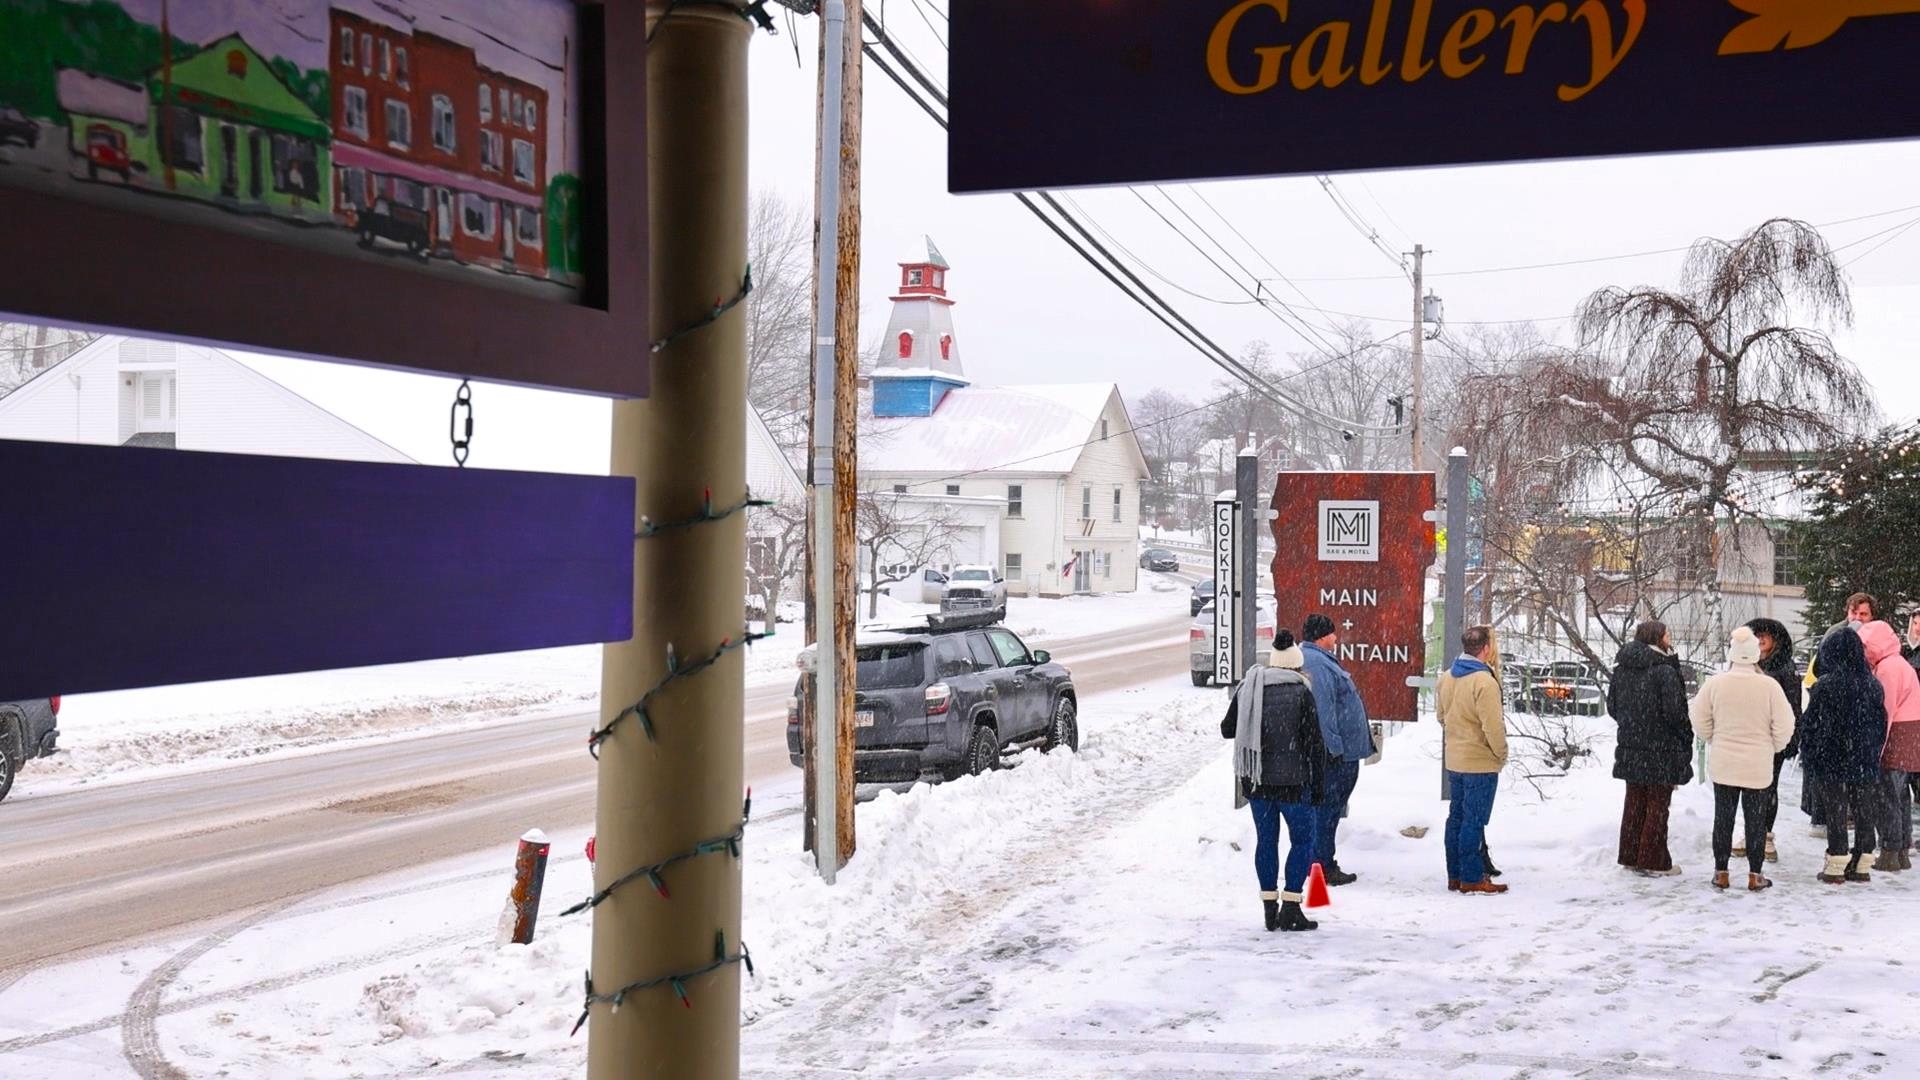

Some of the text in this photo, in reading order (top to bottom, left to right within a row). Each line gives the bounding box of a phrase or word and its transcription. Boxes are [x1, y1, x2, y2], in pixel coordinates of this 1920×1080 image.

[1205, 0, 1647, 102] Gallery
[1218, 507, 1230, 680] COCKTAIL BAR
[1320, 588, 1377, 606] MAIN
[1334, 643, 1409, 664] NTAIN
